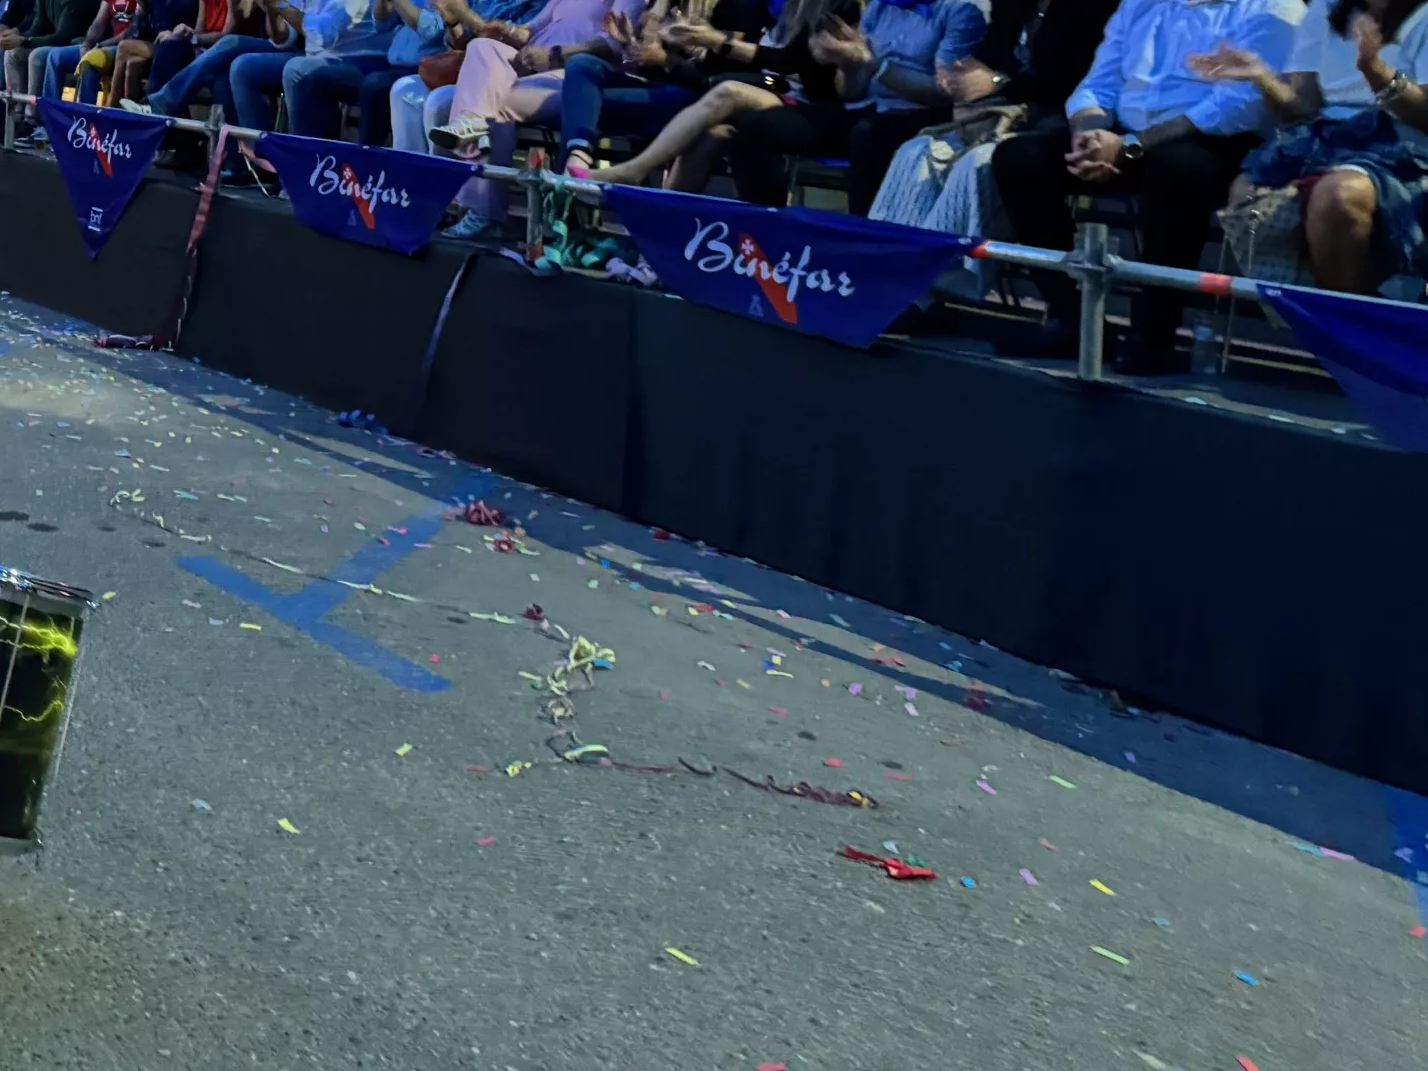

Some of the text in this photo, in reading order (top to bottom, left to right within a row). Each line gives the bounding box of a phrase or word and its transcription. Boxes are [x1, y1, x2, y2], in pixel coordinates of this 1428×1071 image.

[67, 115, 132, 164] Binéfar
[309, 153, 410, 214] Binéfar
[684, 217, 855, 303] Binéfar
